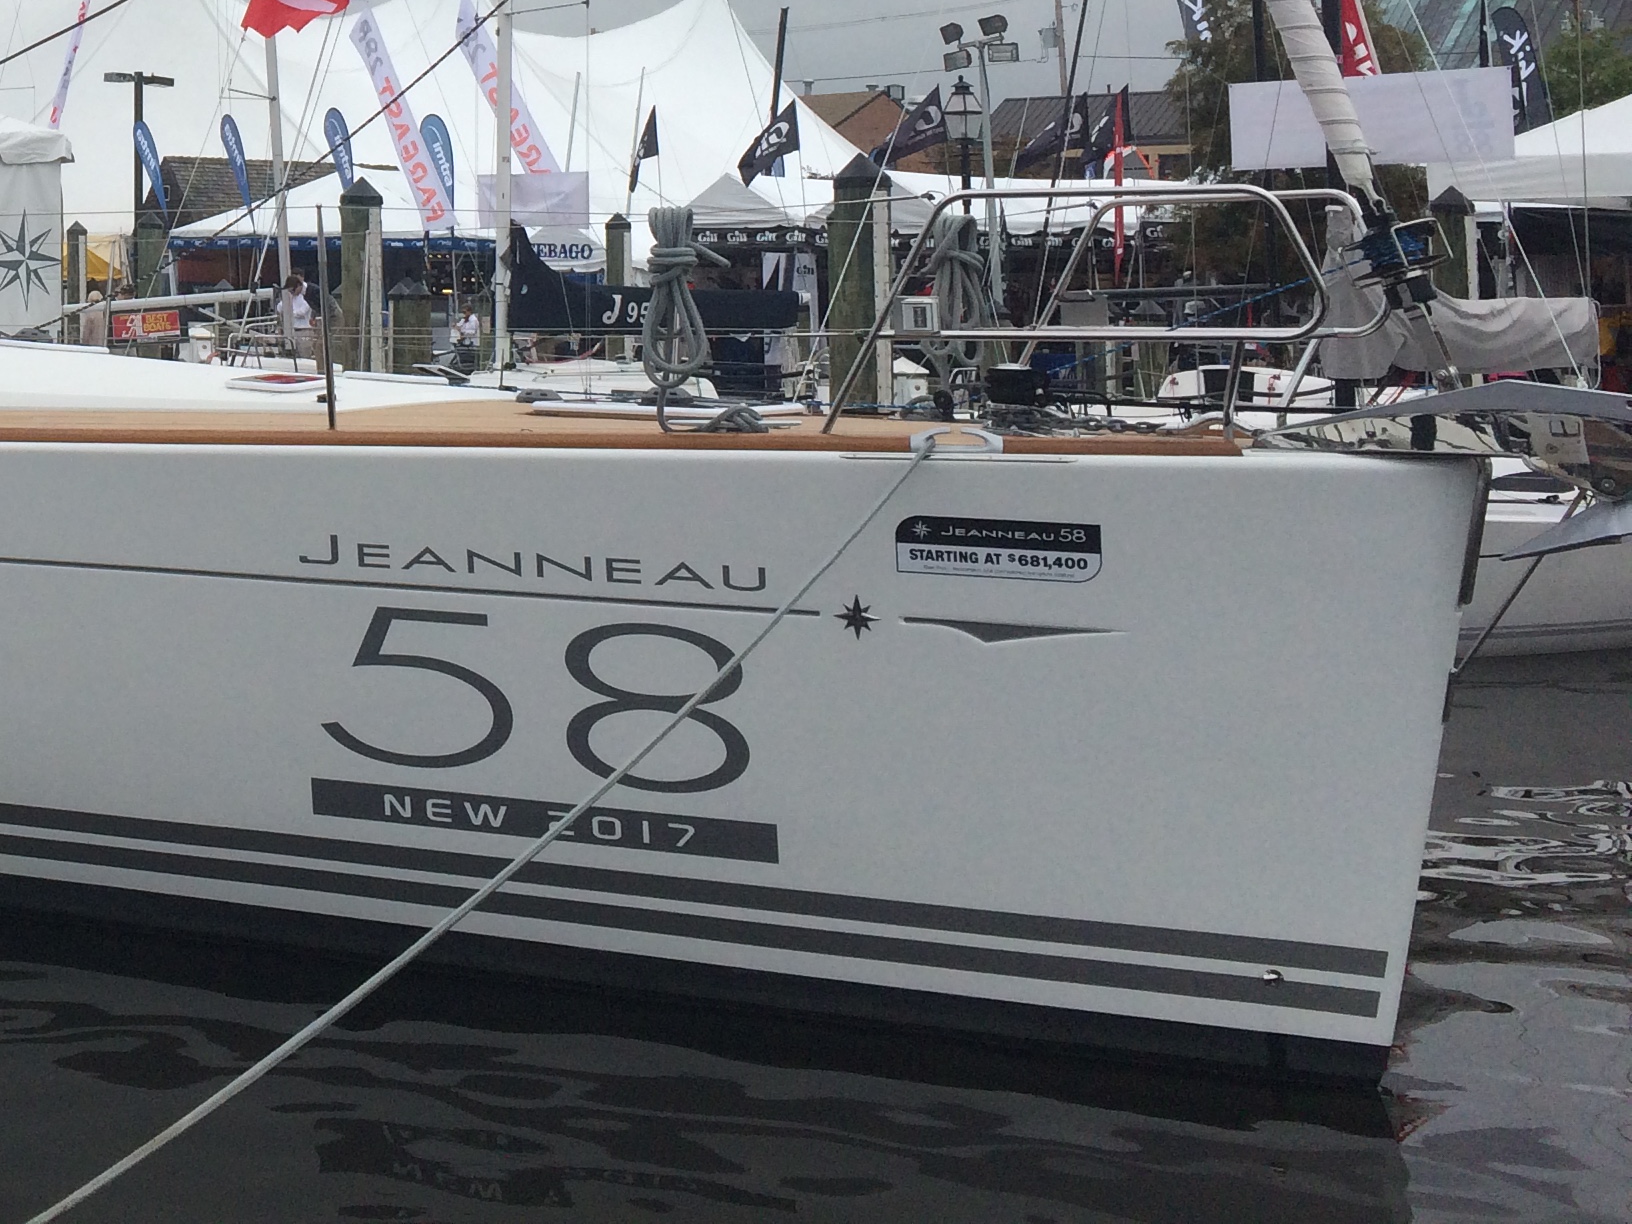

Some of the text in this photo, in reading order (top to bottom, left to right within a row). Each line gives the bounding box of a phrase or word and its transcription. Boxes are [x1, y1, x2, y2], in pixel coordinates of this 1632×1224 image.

[432, 141, 454, 188] imtra
[145, 313, 169, 324] BEST
[601, 294, 623, 325] J
[143, 321, 172, 332] BOATS
[940, 525, 1087, 543] JEANNEAU 58
[298, 533, 768, 593] JEANNEAU
[908, 548, 1089, 571] STARTING AT $681,400
[319, 605, 752, 795] 58
[382, 792, 508, 829] NEW
